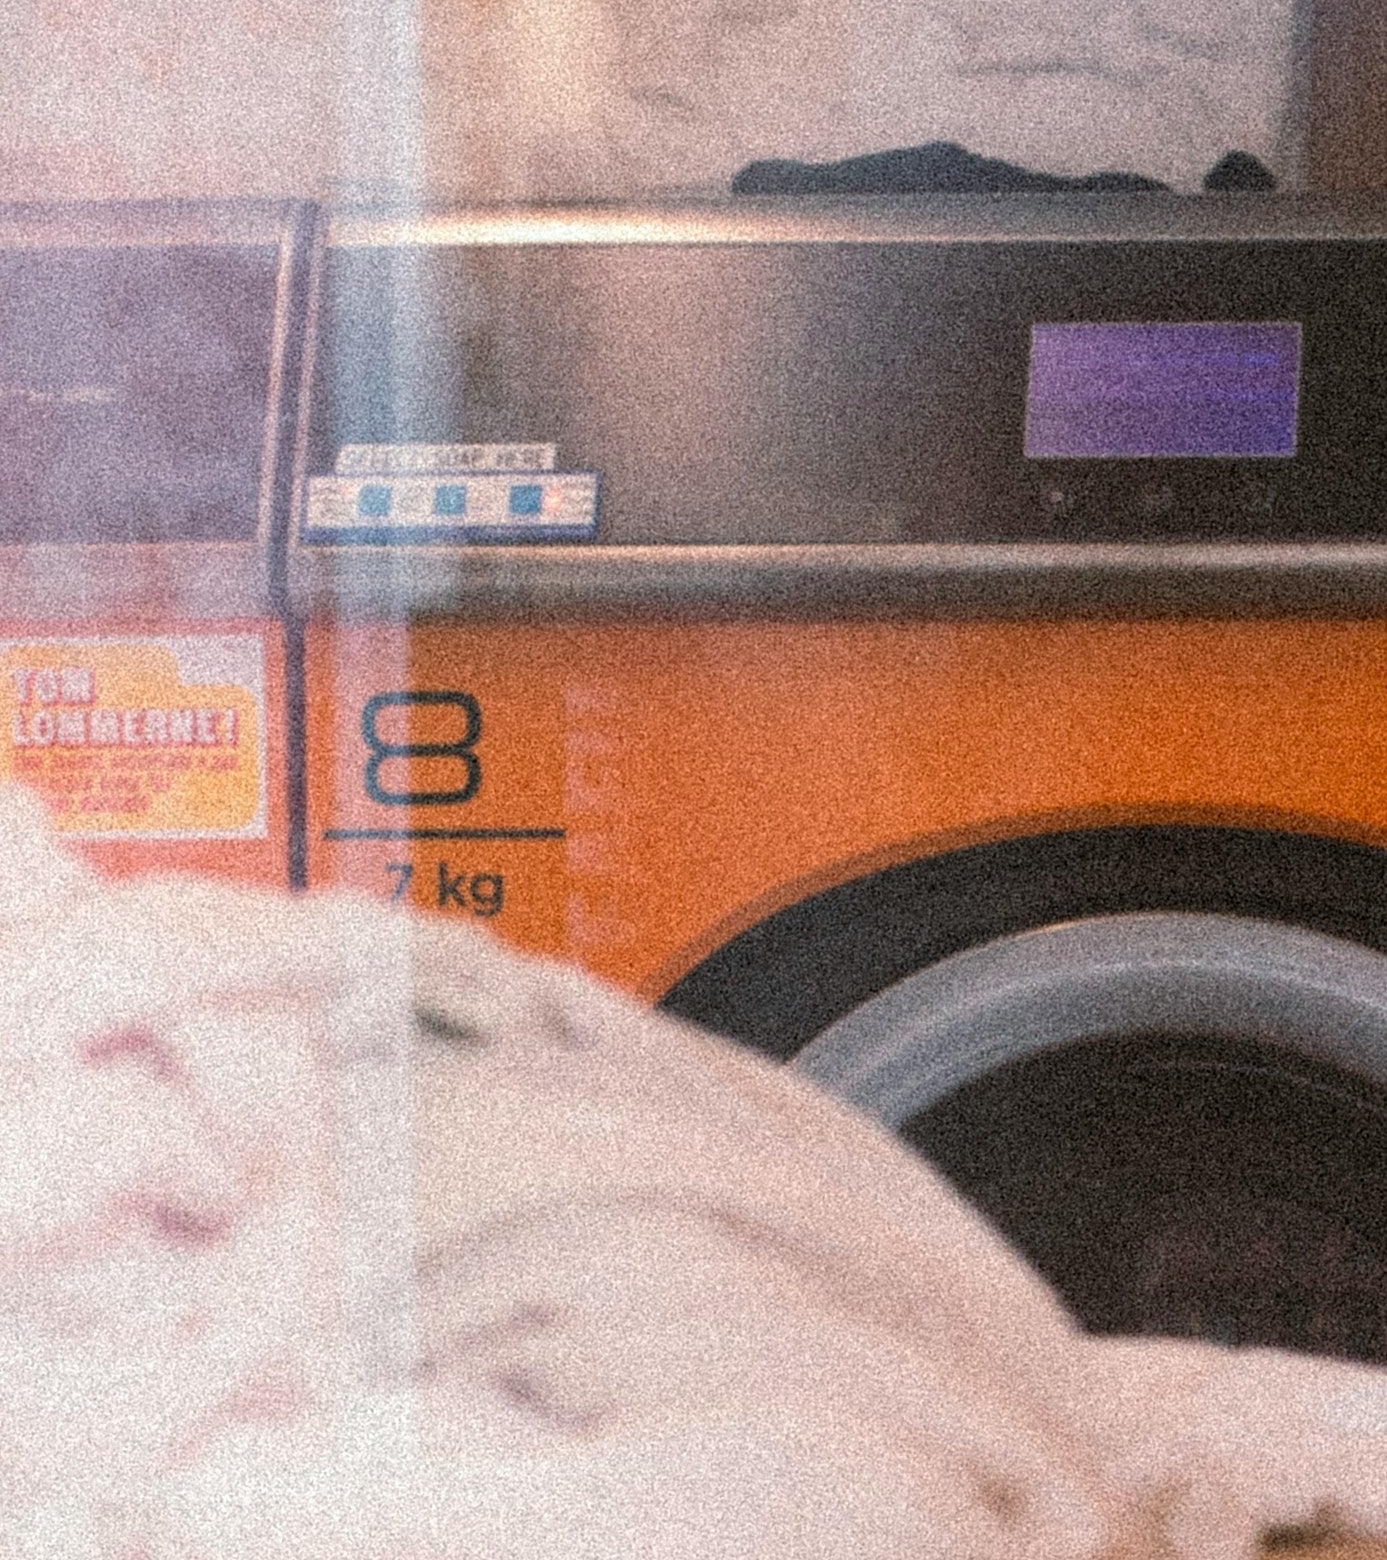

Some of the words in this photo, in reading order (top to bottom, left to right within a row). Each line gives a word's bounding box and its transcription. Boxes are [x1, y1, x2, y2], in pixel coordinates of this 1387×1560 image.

[12, 667, 97, 707] TOM
[12, 708, 241, 747] LOMMERNE!
[361, 690, 484, 806] 8
[438, 861, 505, 917] kg
